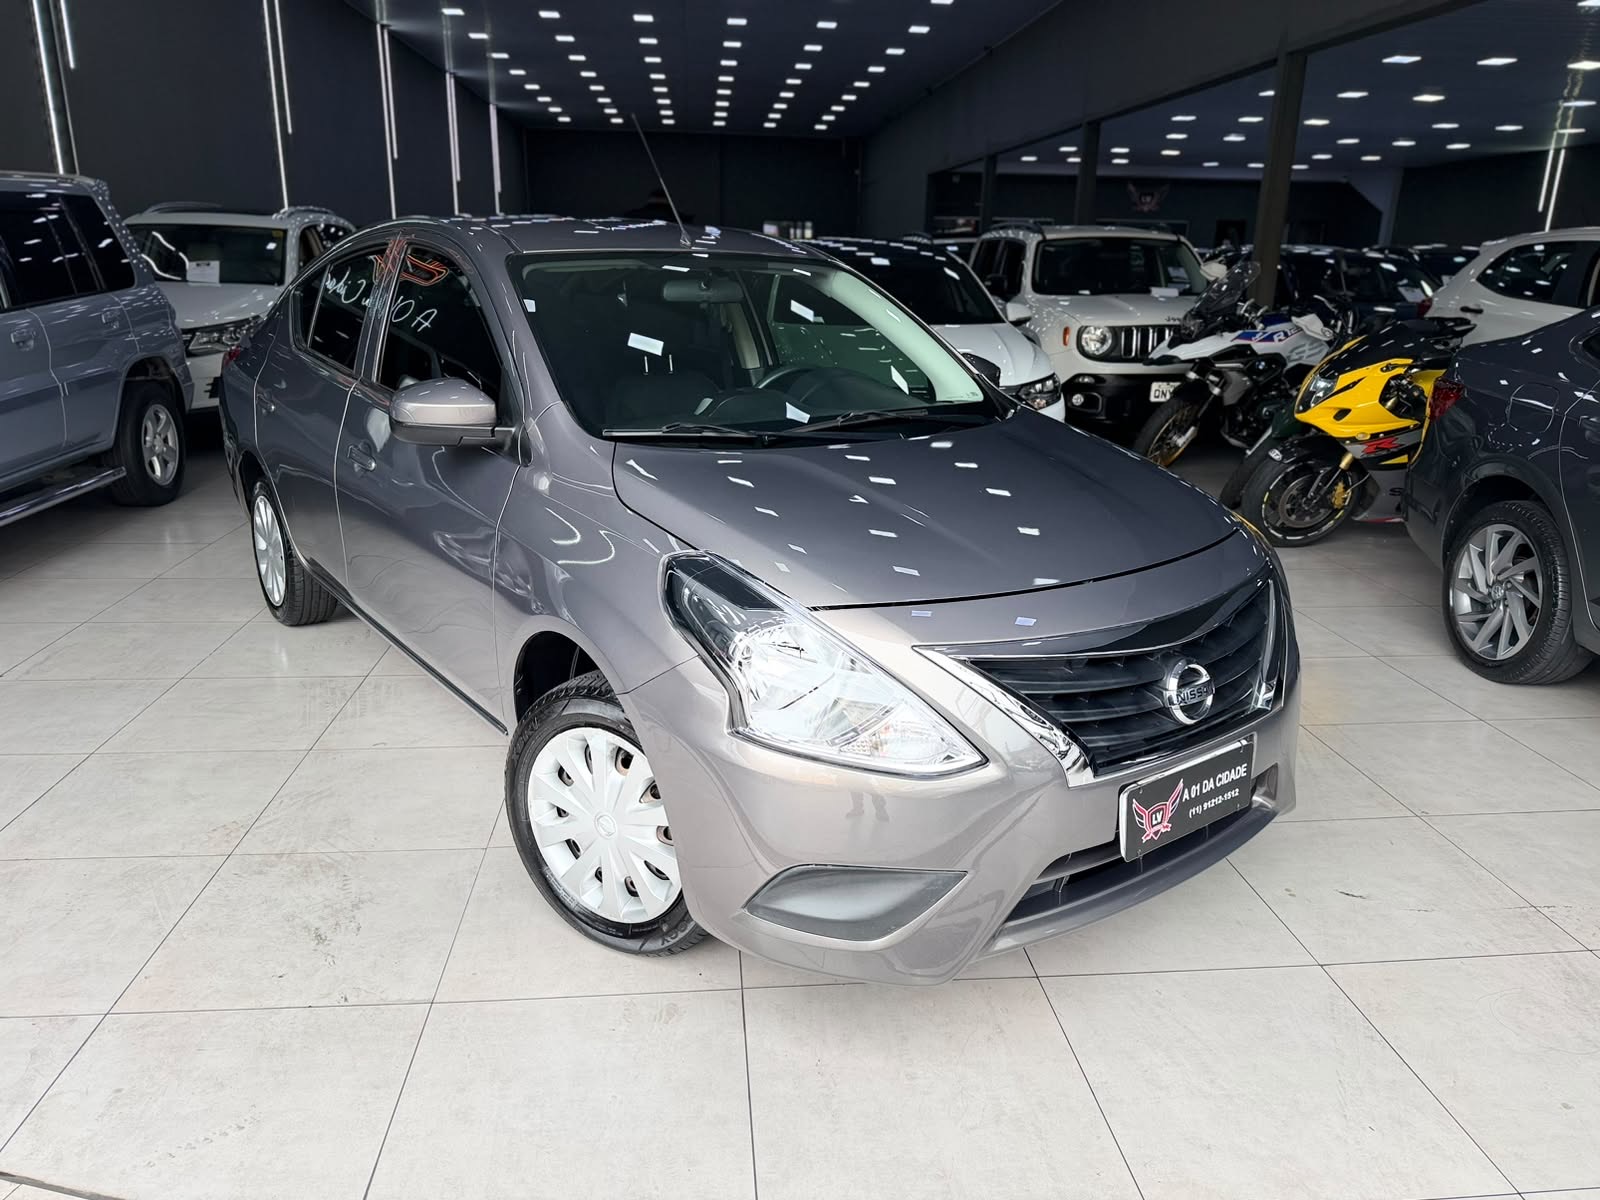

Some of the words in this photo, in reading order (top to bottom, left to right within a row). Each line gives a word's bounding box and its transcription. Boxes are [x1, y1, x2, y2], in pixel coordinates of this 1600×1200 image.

[1176, 684, 1211, 704] NISSA
[1182, 788, 1190, 802] A
[1190, 783, 1200, 798] 01
[1202, 777, 1215, 793] DA
[1215, 763, 1248, 787] CIDADE
[1152, 810, 1163, 825] LV
[1188, 805, 1202, 818] (11)
